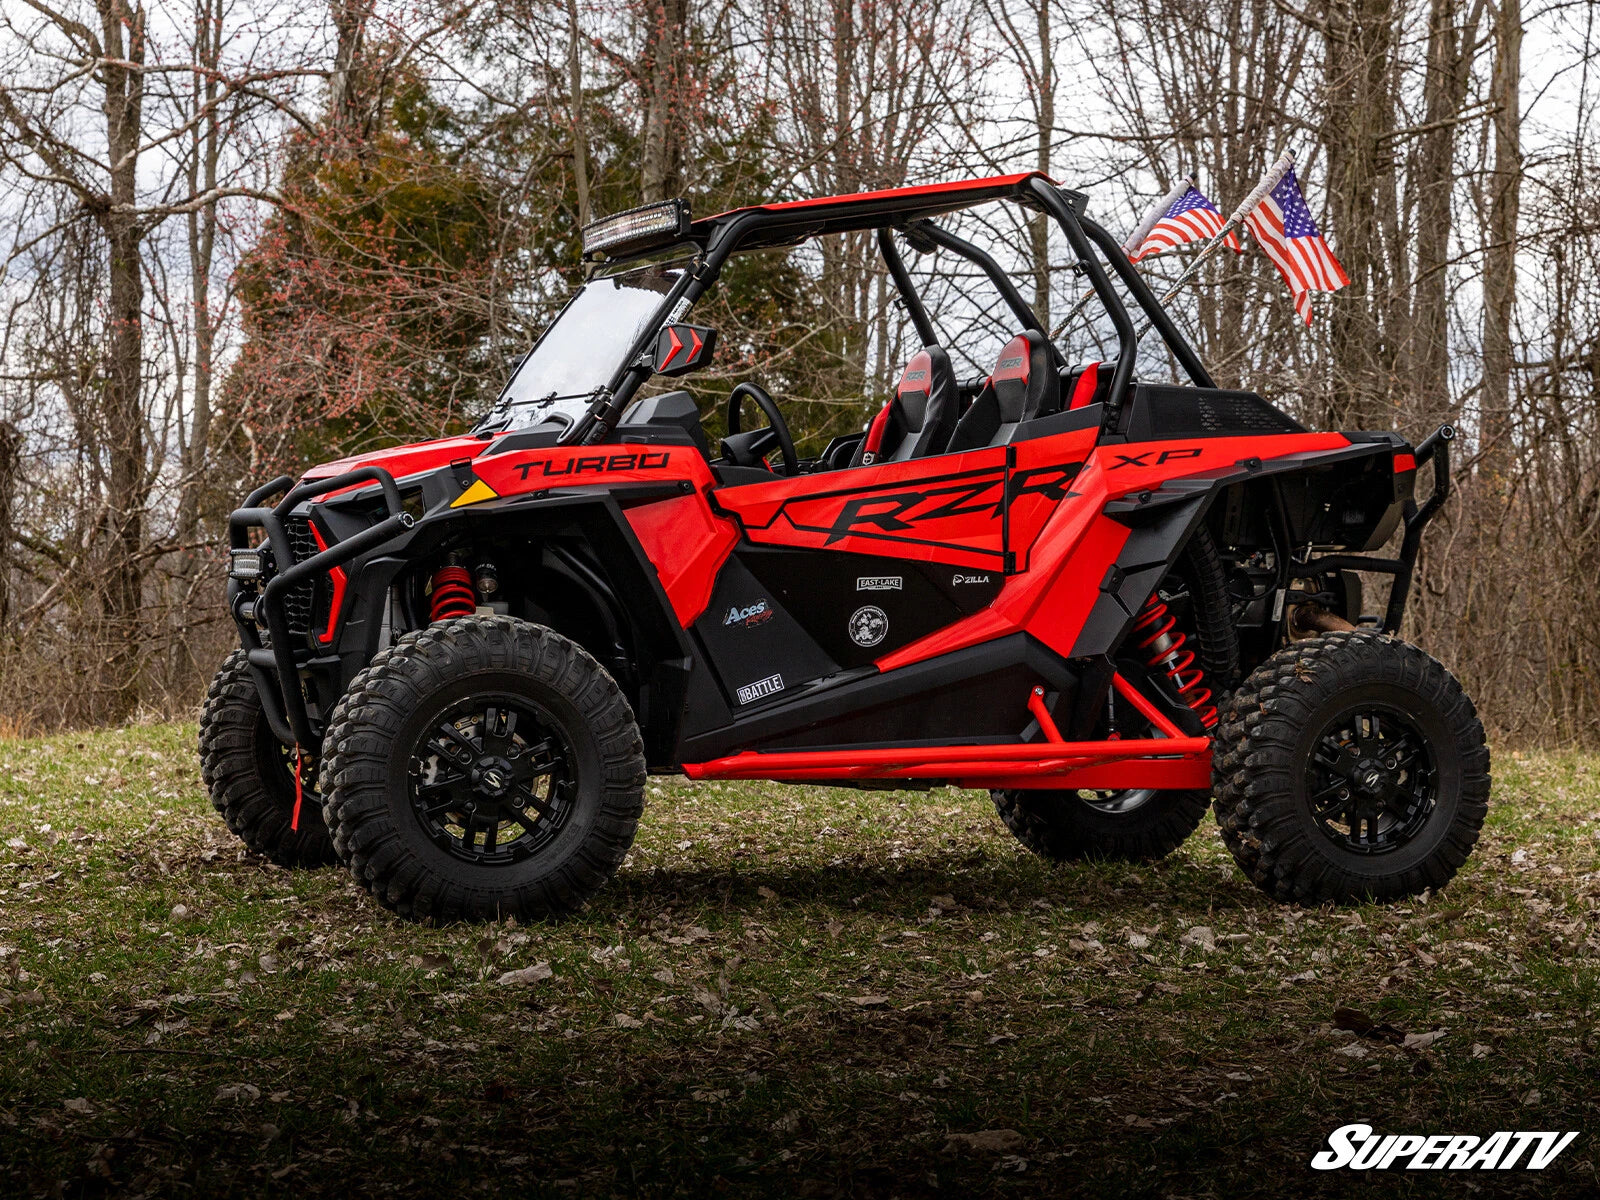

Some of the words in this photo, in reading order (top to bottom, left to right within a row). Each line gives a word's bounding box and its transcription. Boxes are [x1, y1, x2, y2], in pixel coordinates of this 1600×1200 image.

[512, 452, 671, 480] TURBO
[1107, 448, 1203, 470] XP
[823, 461, 1090, 547] RZR
[725, 602, 766, 625] Aces
